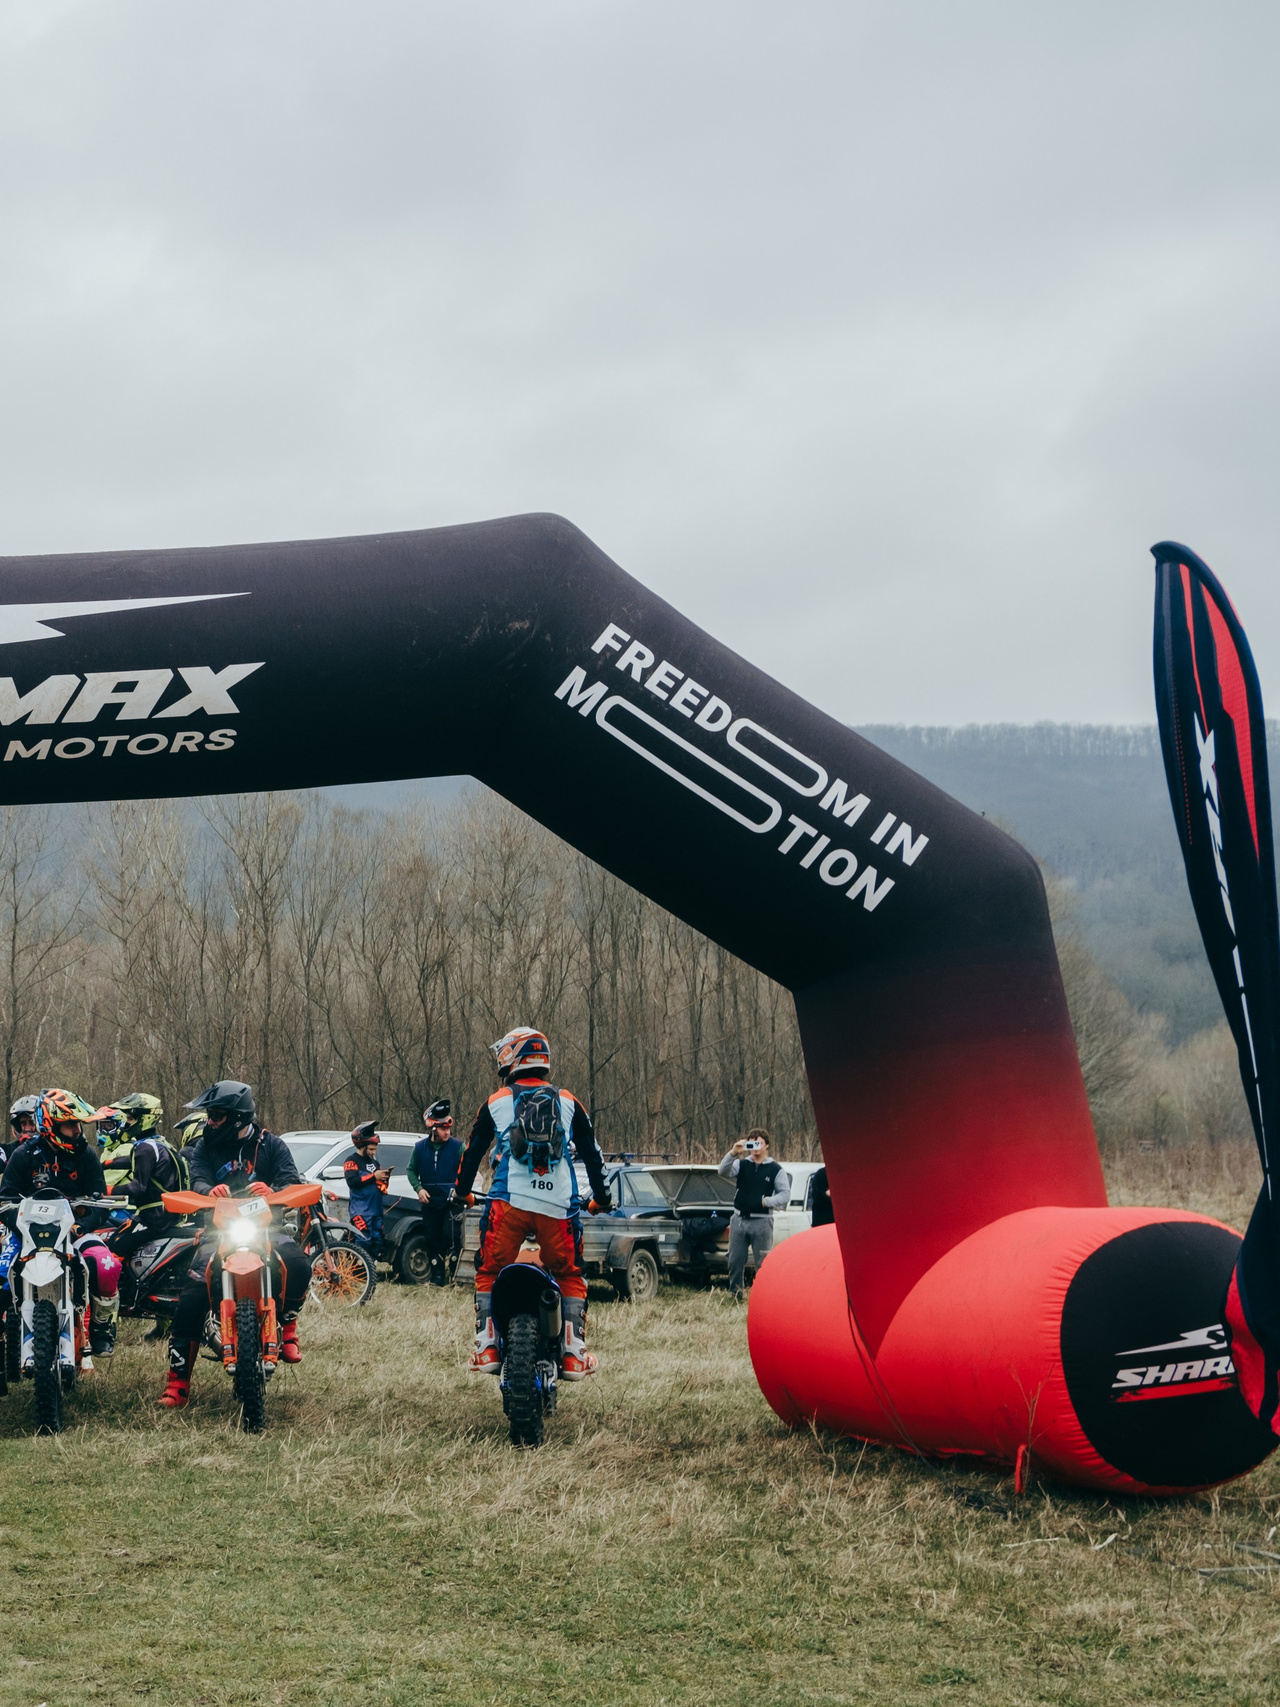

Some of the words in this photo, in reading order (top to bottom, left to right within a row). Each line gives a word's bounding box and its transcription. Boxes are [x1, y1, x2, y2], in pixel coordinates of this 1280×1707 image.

[3, 728, 238, 761] MOTORS
[591, 623, 871, 827] FREEDOM
[869, 812, 929, 866] IN
[554, 666, 895, 912] MOTION
[530, 1179, 554, 1191] 180
[38, 1205, 50, 1213] 13
[246, 1202, 259, 1212] 77
